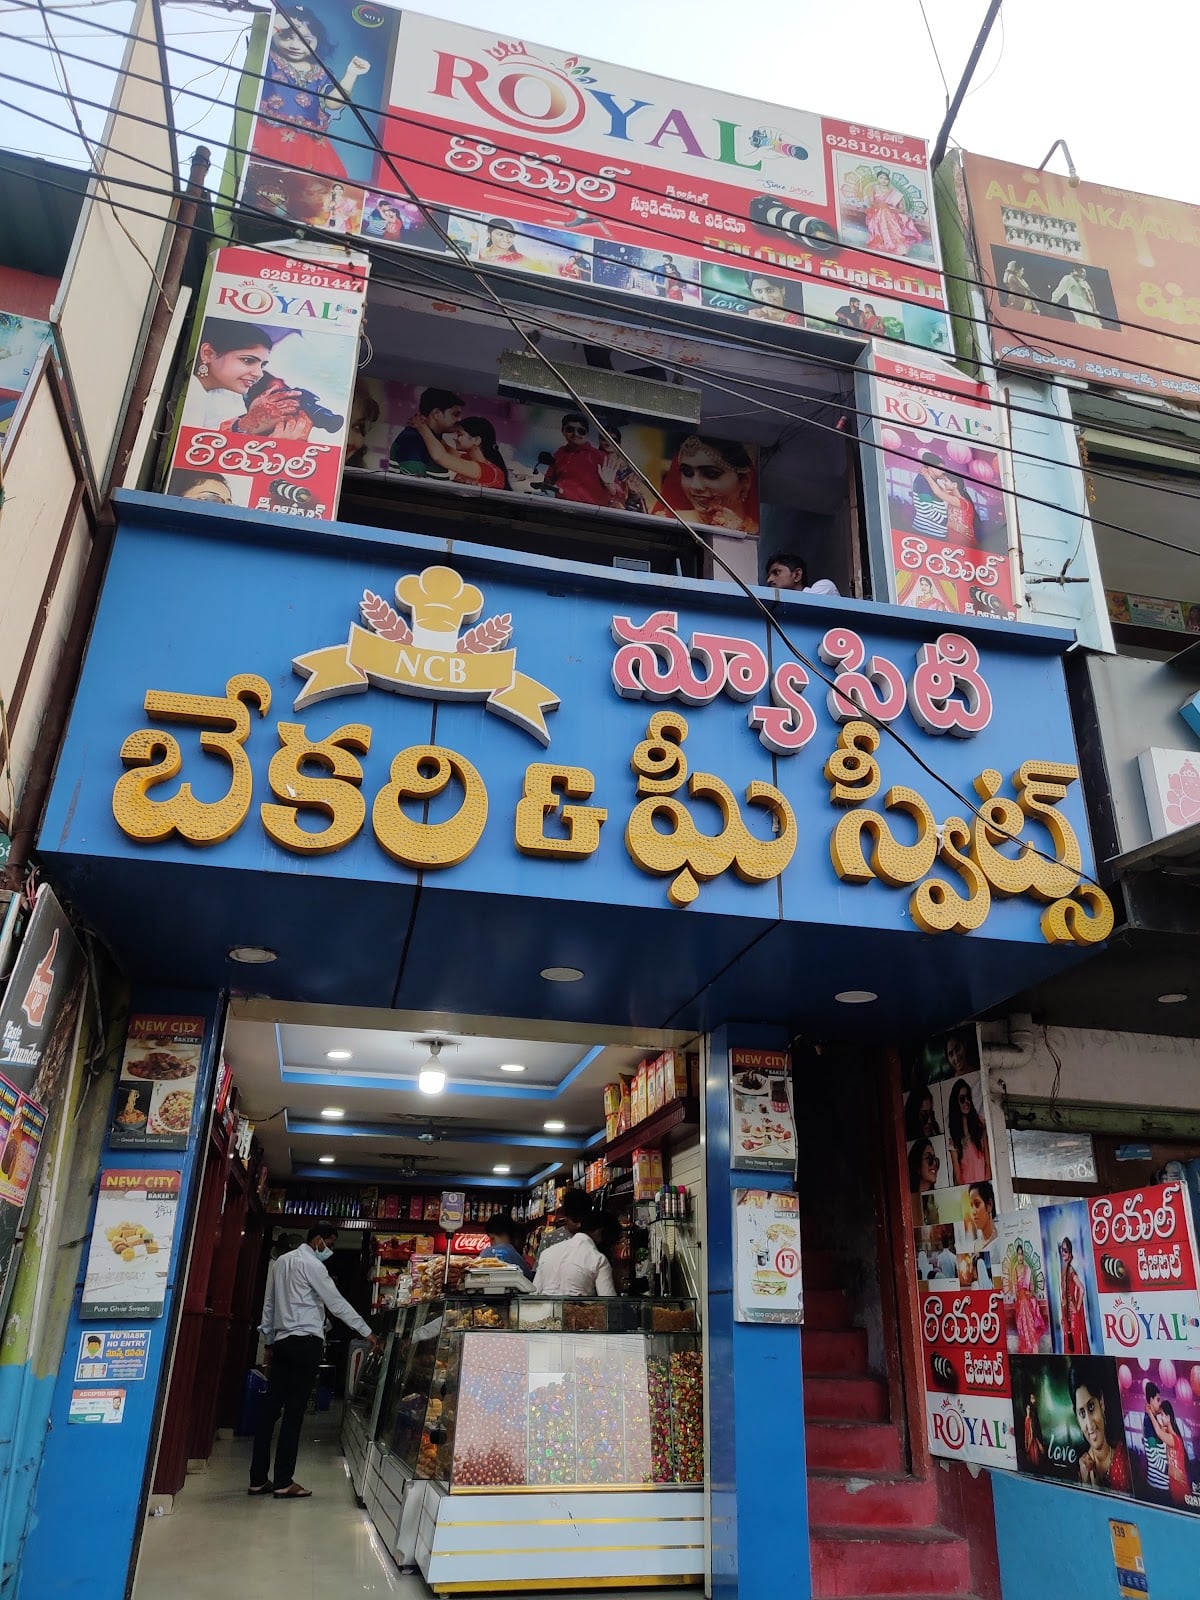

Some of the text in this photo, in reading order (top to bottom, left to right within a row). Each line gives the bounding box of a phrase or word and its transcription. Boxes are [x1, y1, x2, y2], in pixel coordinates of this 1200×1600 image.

[428, 48, 762, 171] ROYAL
[259, 268, 362, 293] 6281201447
[216, 287, 339, 321] ROYAL
[883, 395, 980, 437] ROYAL
[395, 649, 467, 684] NCB
[610, 610, 818, 756] న్యూ
[514, 762, 608, 860] &
[134, 1020, 199, 1033] NEW CITY
[735, 1054, 762, 1065] NEW
[106, 1176, 175, 1188] NEW CITY
[147, 1192, 175, 1200] BAKERY
[93, 1305, 108, 1313] Pure
[128, 1304, 151, 1313] Sweets
[106, 1340, 146, 1348] NO ENTRY
[110, 1331, 146, 1340] NO MASK
[1103, 1312, 1188, 1348] ROYAL
[932, 1412, 1007, 1450] ROYAL
